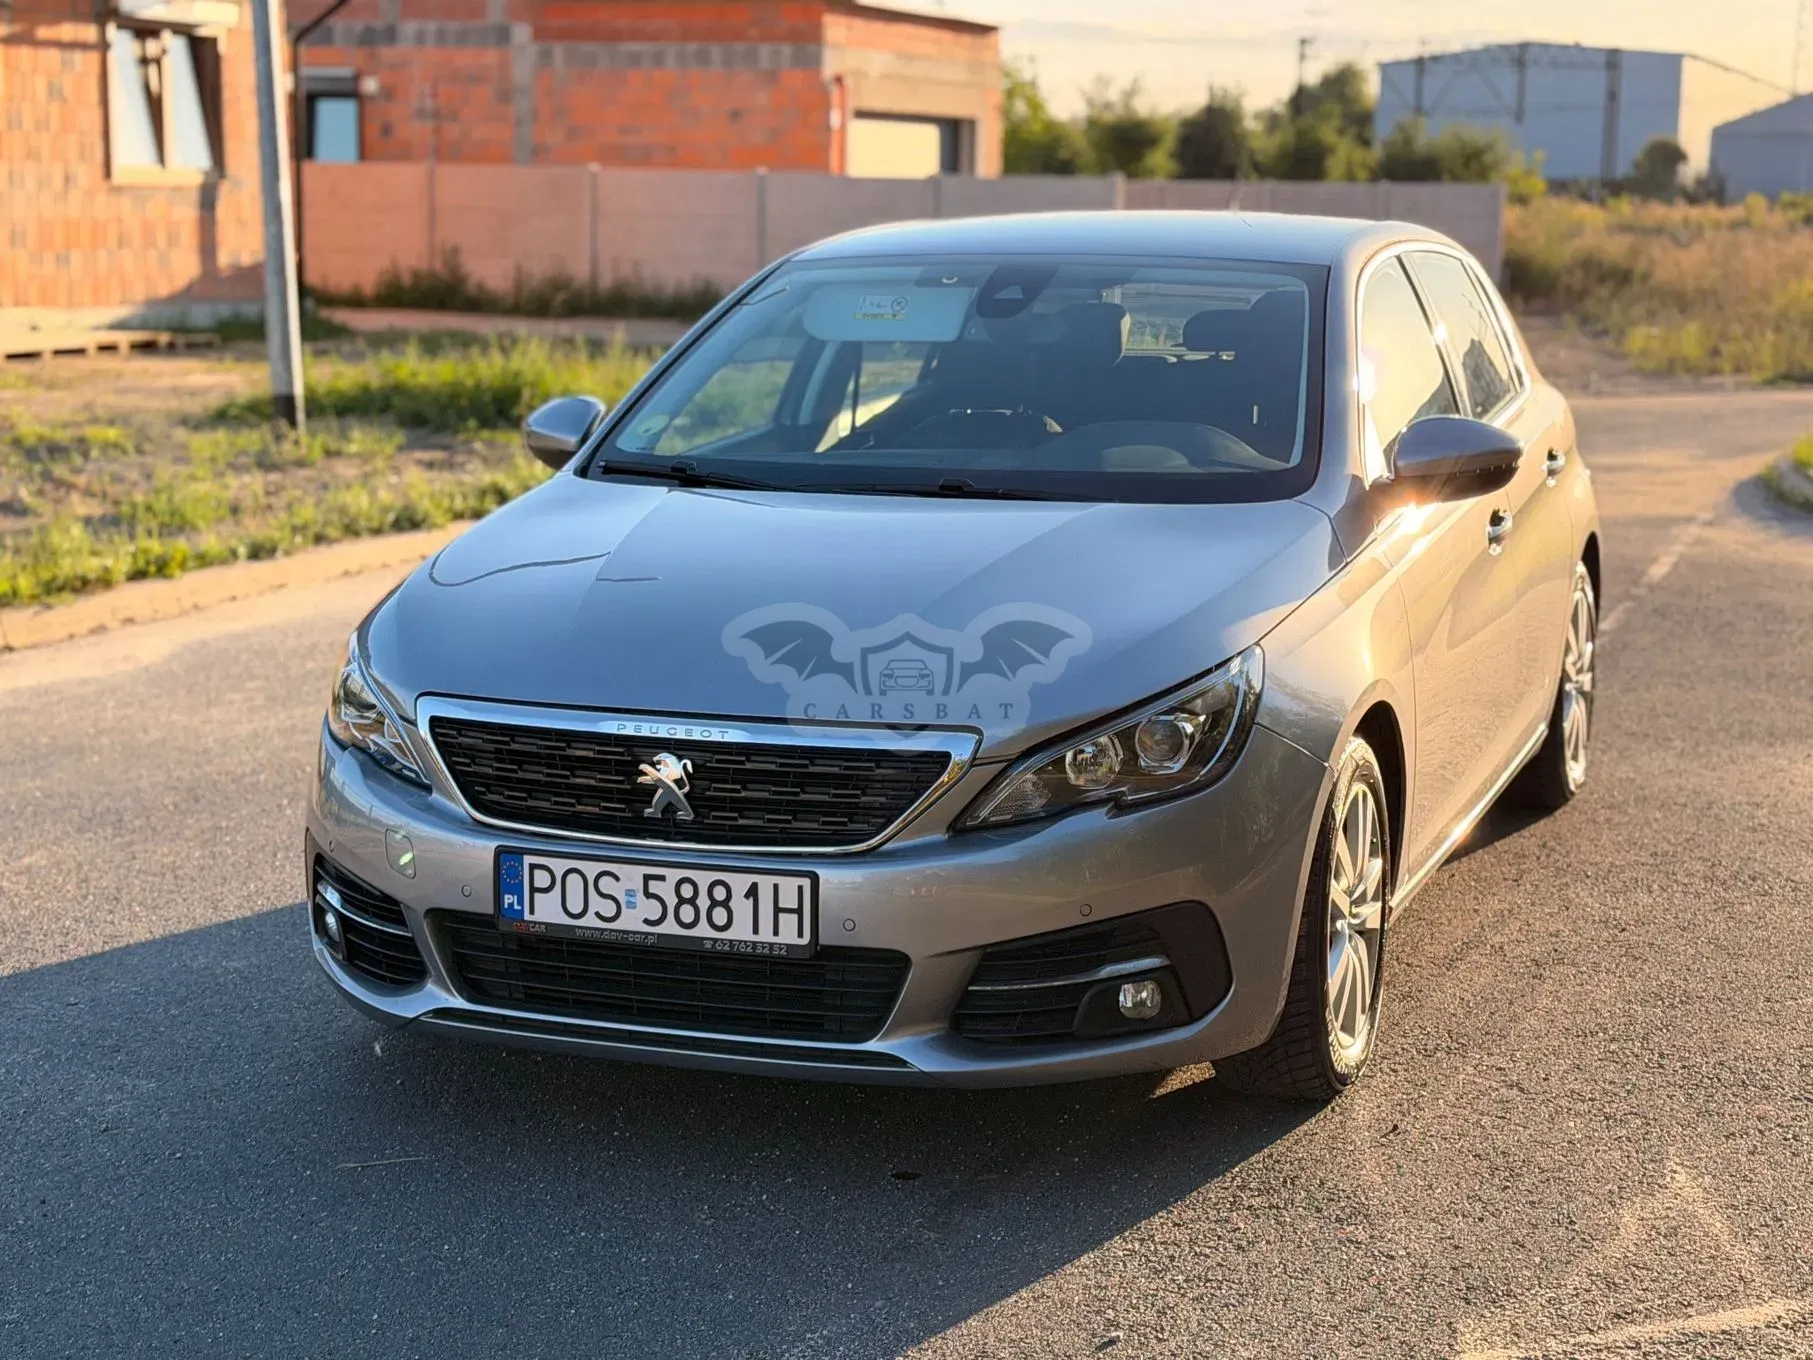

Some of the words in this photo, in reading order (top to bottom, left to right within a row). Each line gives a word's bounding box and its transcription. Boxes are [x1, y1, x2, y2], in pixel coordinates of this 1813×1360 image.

[616, 723, 729, 739] PEUGEOT
[504, 894, 521, 910] PL
[528, 863, 622, 923] POS
[642, 873, 804, 939] 5881H
